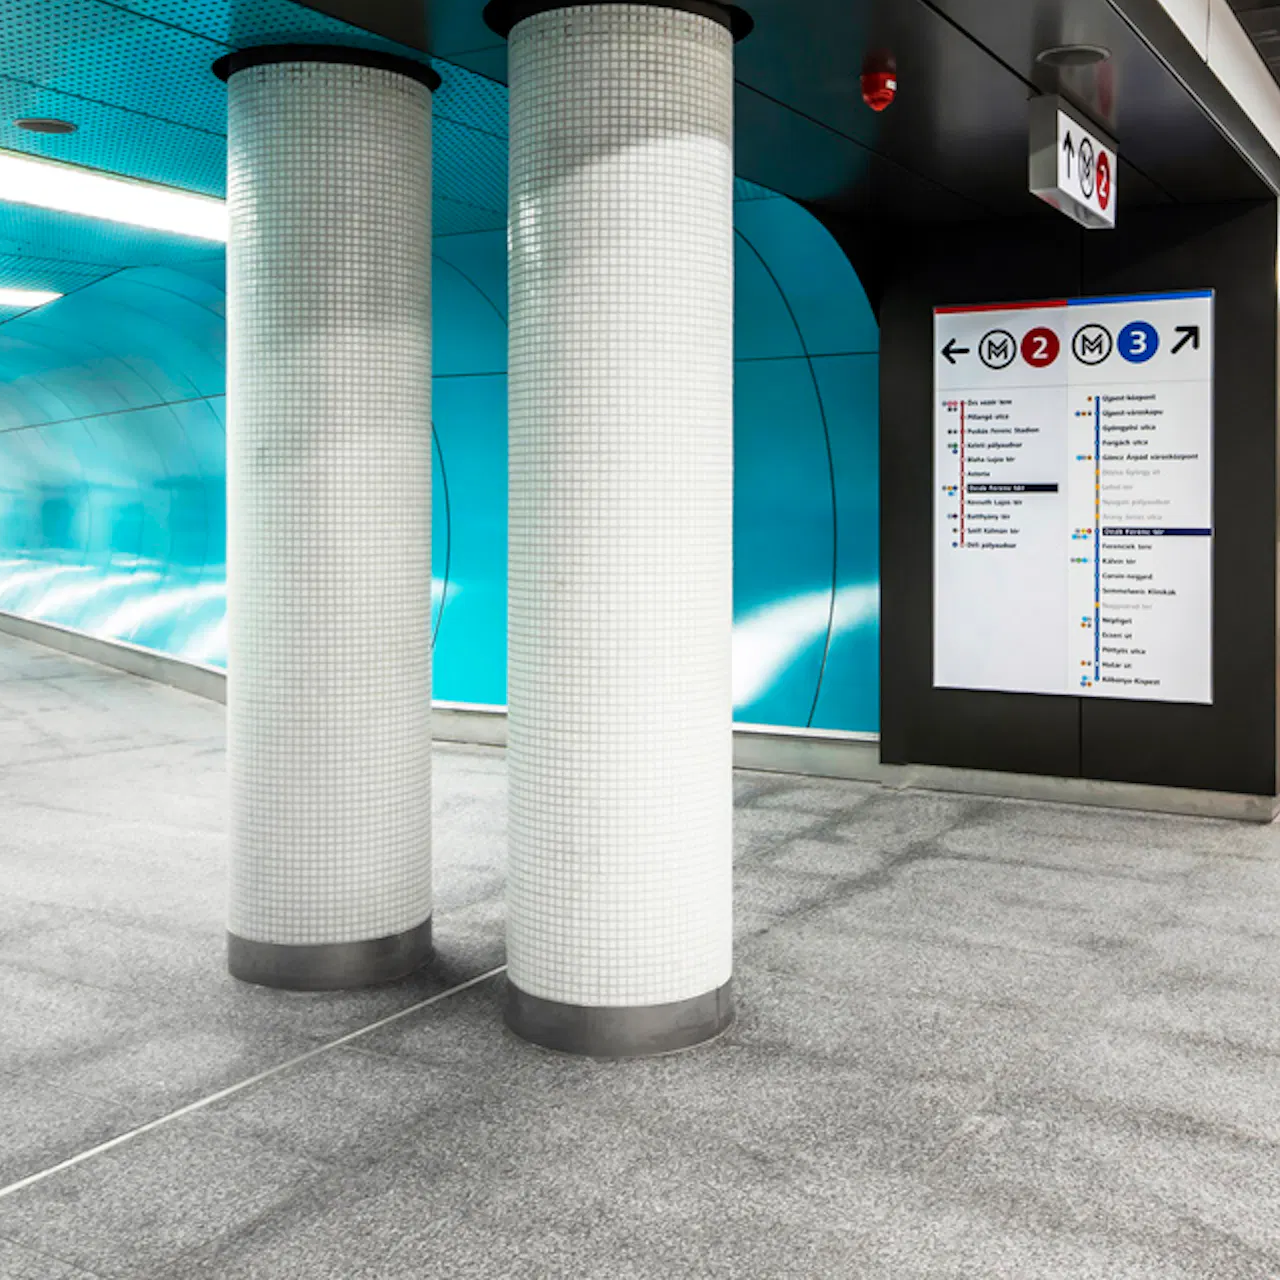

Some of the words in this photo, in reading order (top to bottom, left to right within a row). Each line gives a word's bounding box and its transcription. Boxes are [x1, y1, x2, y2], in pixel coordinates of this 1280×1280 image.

[1099, 165, 1108, 197] 2
[1032, 336, 1048, 360] 2
[1129, 329, 1147, 355] 3
